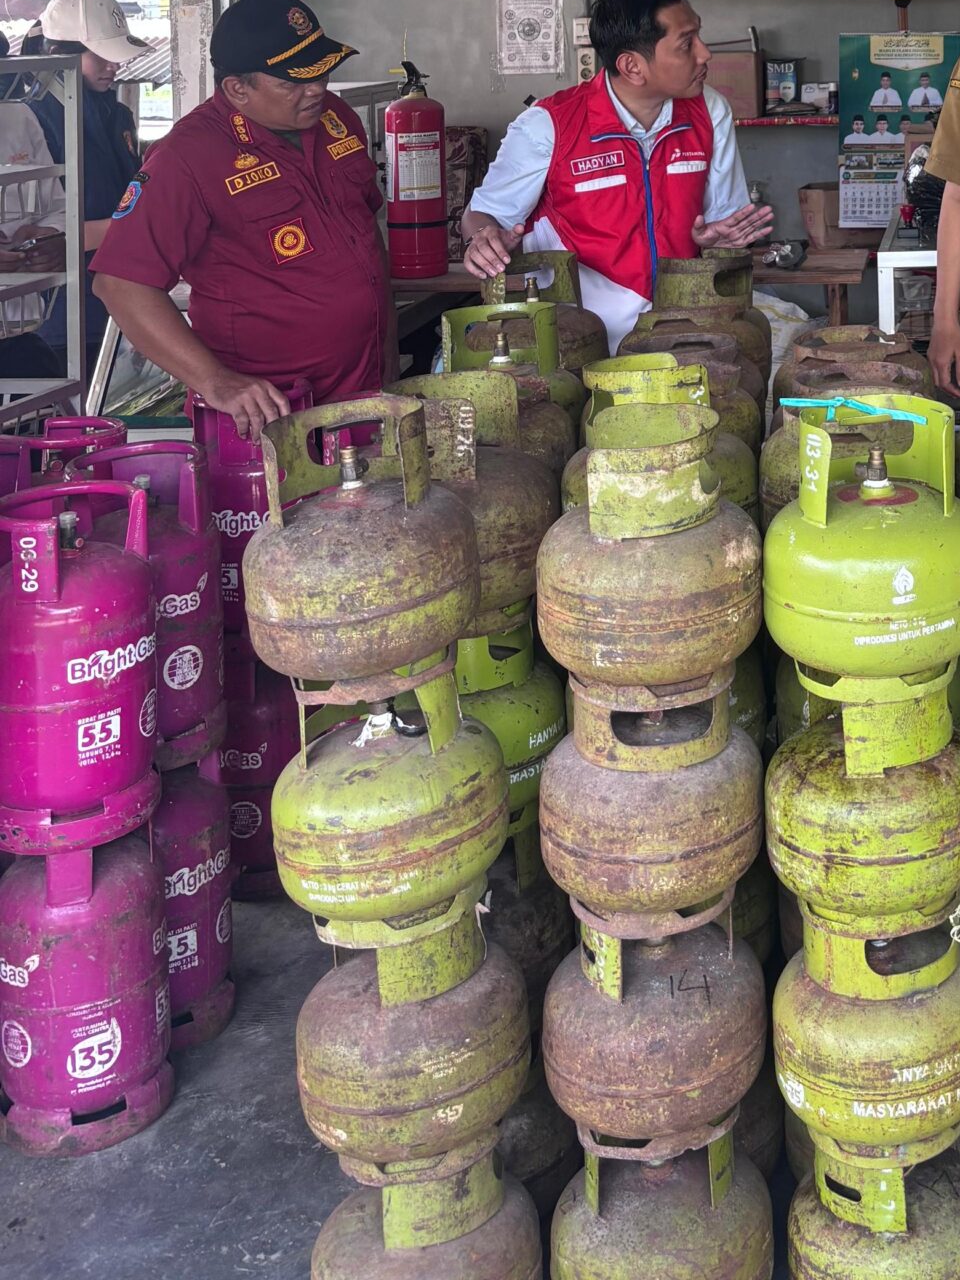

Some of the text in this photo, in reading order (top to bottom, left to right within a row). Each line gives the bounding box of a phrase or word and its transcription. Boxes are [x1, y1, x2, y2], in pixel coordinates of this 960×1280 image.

[766, 62, 794, 74] SMD
[577, 153, 618, 172] HADYAN
[233, 167, 273, 190] DJOKO
[164, 590, 200, 618] Gas
[854, 617, 956, 646] DIPRODUKSI UNTUK PERTAMINA
[68, 644, 138, 684] Bright
[528, 721, 558, 749] HANYA
[70, 1020, 108, 1035] PERTAMINA
[72, 1023, 111, 1039] CALL CENTER
[70, 1040, 115, 1073] 135
[852, 1090, 953, 1118] MASYARAKAT
